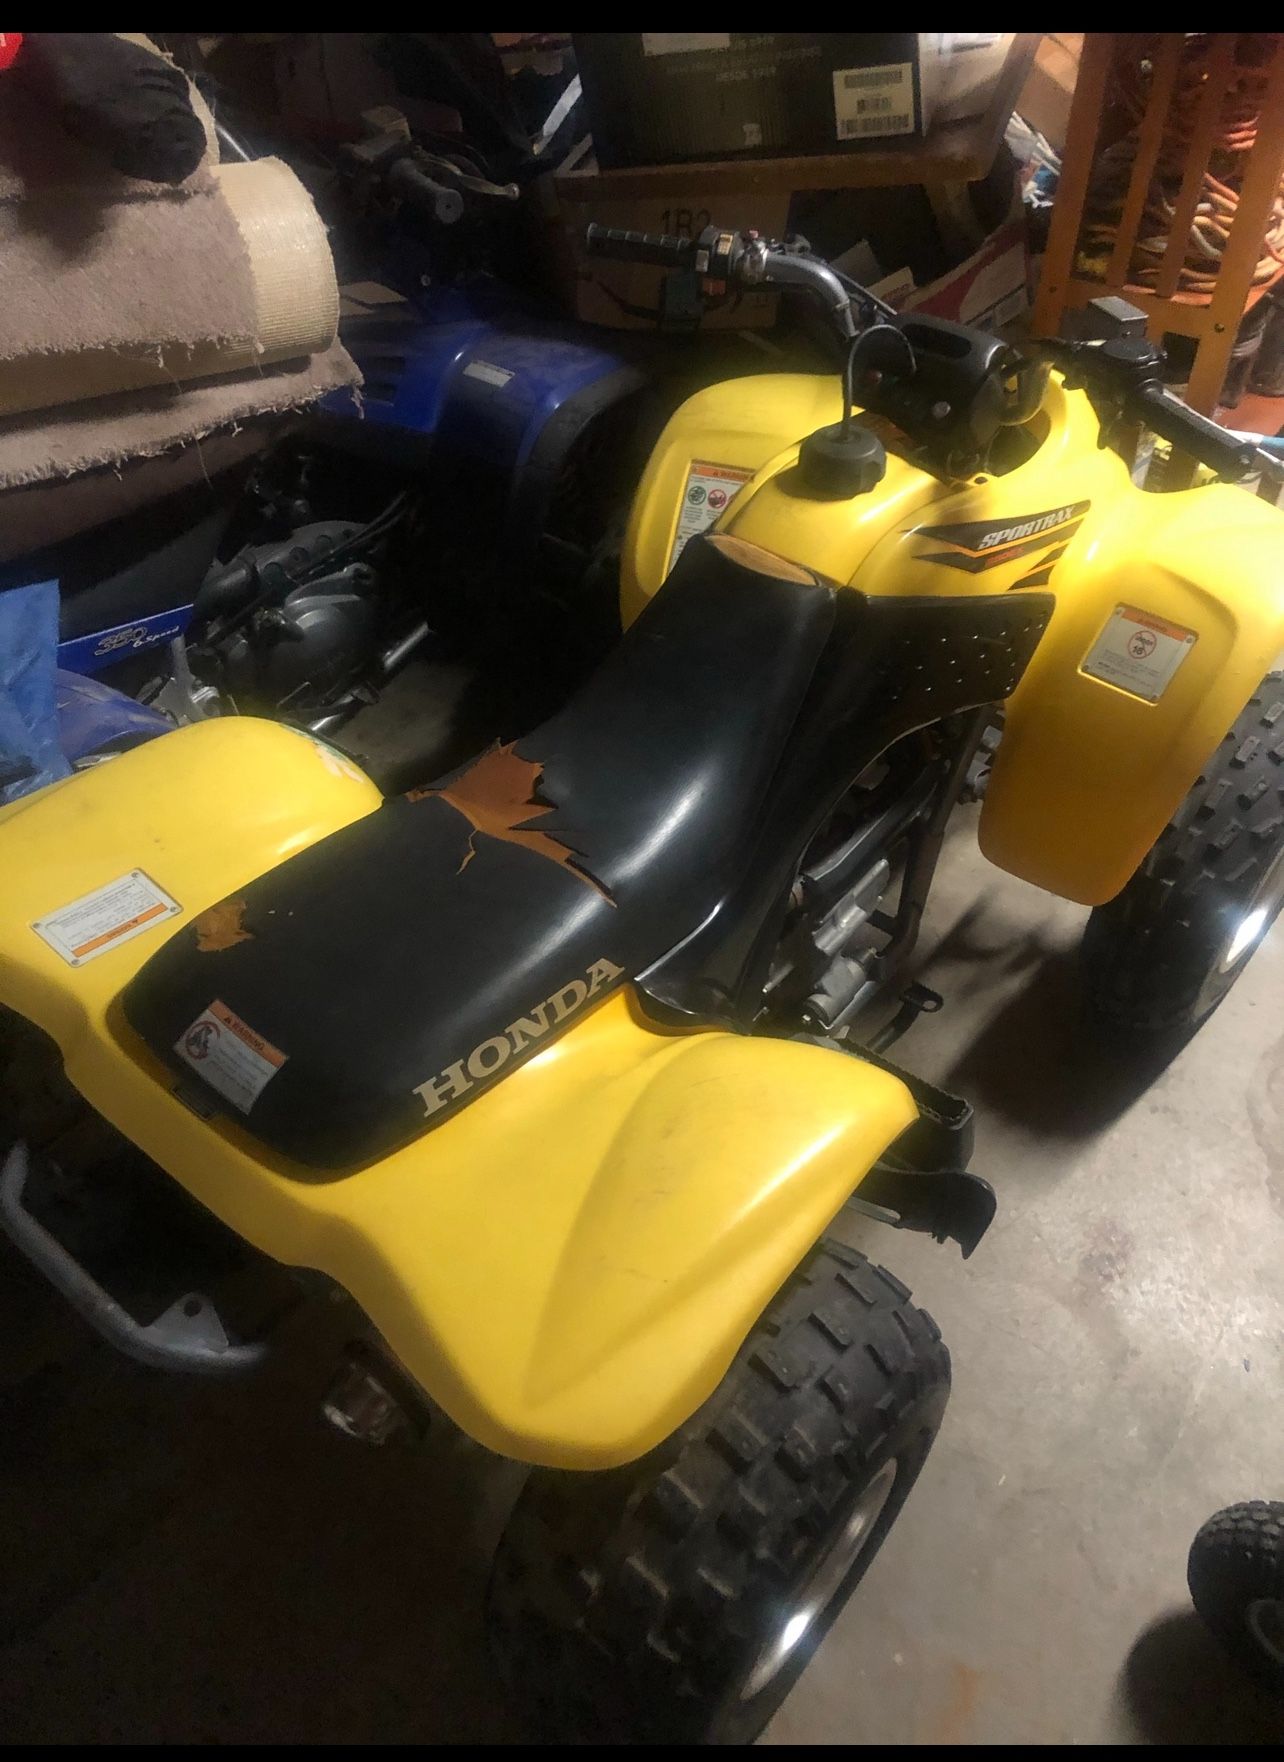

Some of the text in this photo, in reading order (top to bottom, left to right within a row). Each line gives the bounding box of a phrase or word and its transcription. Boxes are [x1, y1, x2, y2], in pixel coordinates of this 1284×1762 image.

[978, 506, 1075, 550] SPORTRAX
[94, 626, 148, 656] 350
[412, 957, 625, 1118] HONDA
